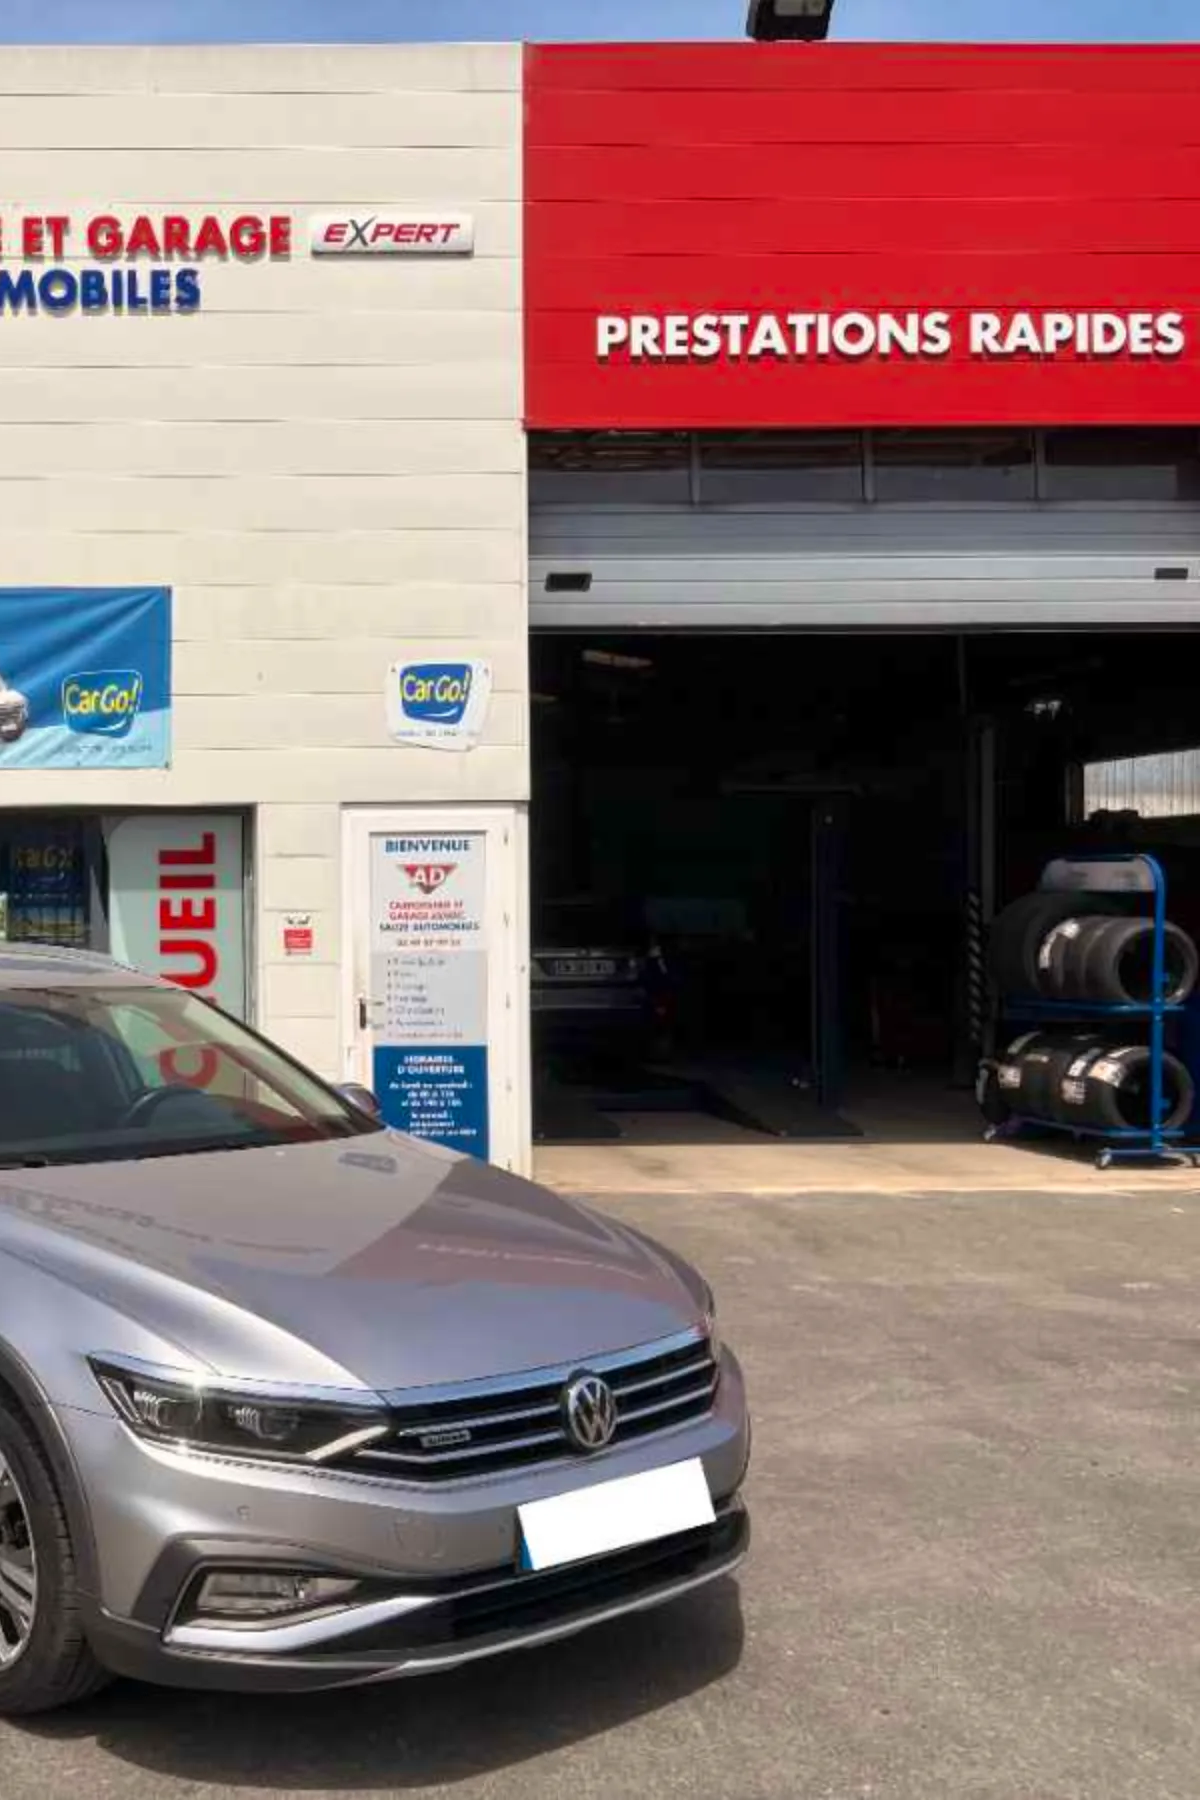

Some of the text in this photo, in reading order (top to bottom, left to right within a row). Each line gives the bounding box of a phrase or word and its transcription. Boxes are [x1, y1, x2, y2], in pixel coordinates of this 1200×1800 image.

[22, 216, 69, 258] ET
[87, 215, 291, 259] GARAGE
[596, 311, 1185, 359] PRESTATIONS RAPIDES
[385, 839, 472, 853] BIENVENUE
[413, 867, 446, 886] AD
